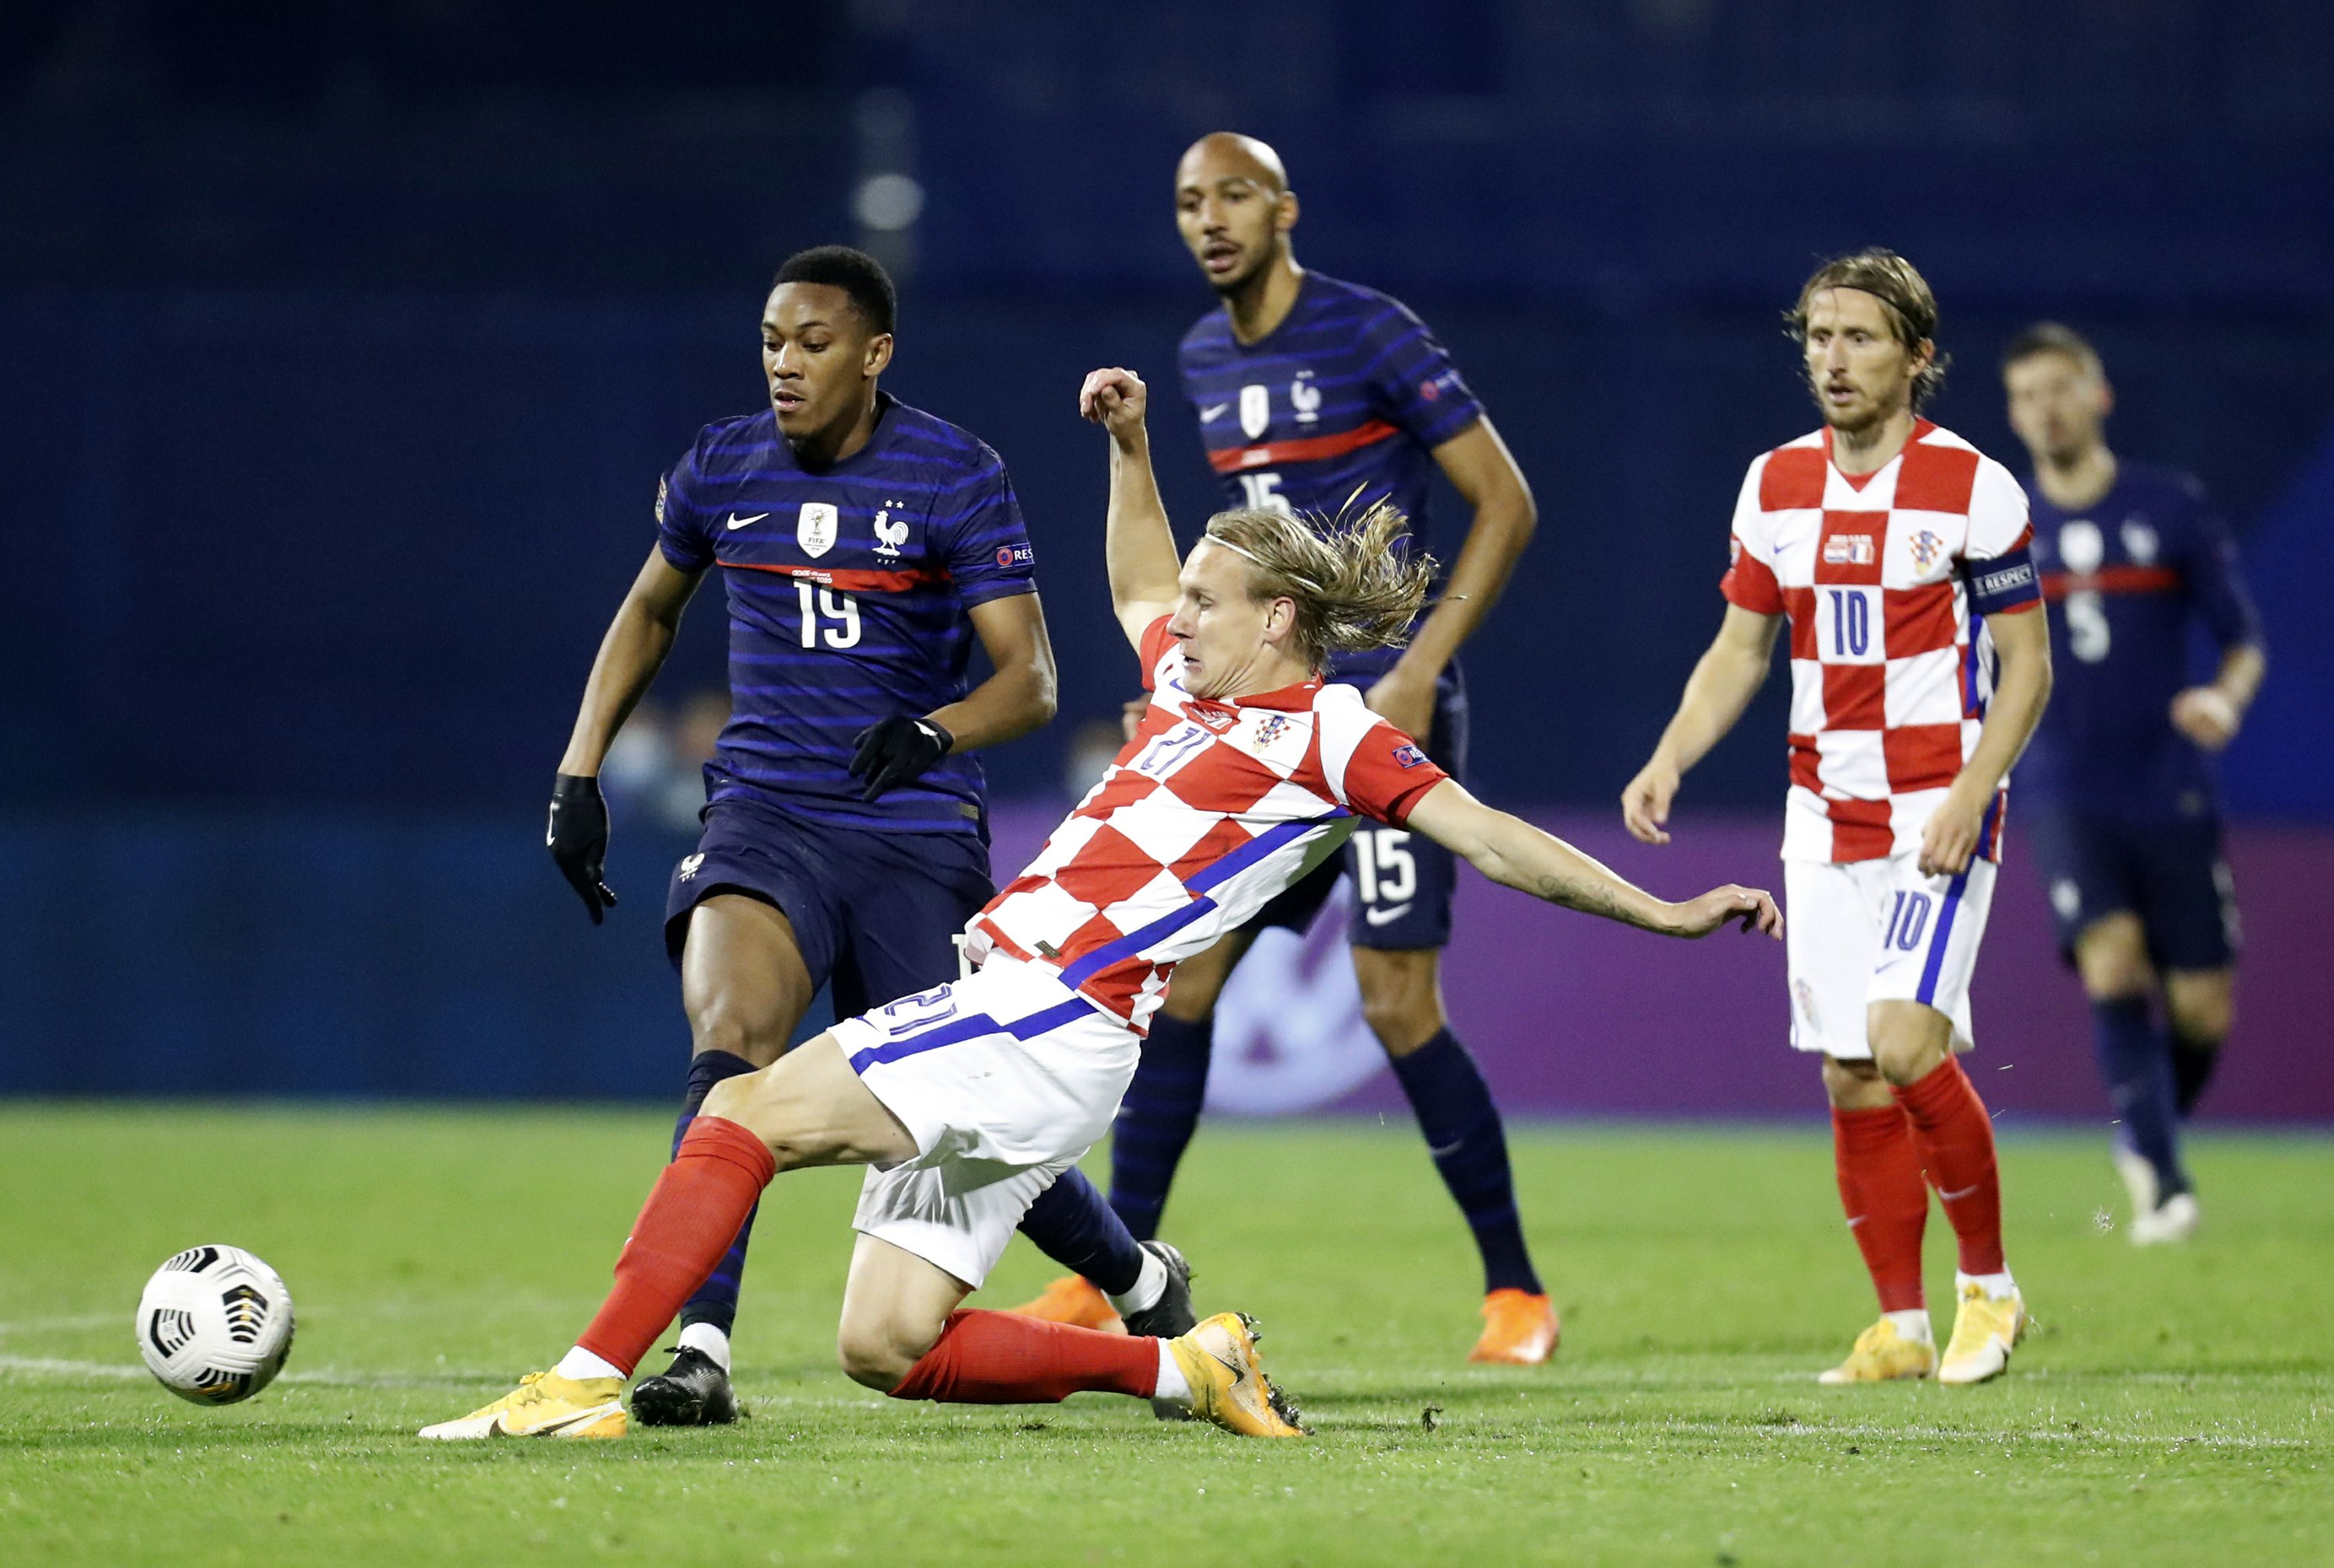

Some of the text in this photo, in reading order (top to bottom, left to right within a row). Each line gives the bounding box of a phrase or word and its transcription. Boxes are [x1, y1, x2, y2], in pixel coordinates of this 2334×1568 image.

[1240, 472, 1291, 514] 15
[1985, 567, 2031, 590] RESPECT
[794, 578, 861, 649] 19
[1828, 590, 1869, 656] 10
[1140, 726, 1212, 776] 21
[1352, 828, 1417, 903] 15
[1884, 891, 1932, 951] 10
[884, 985, 958, 1036] 21
